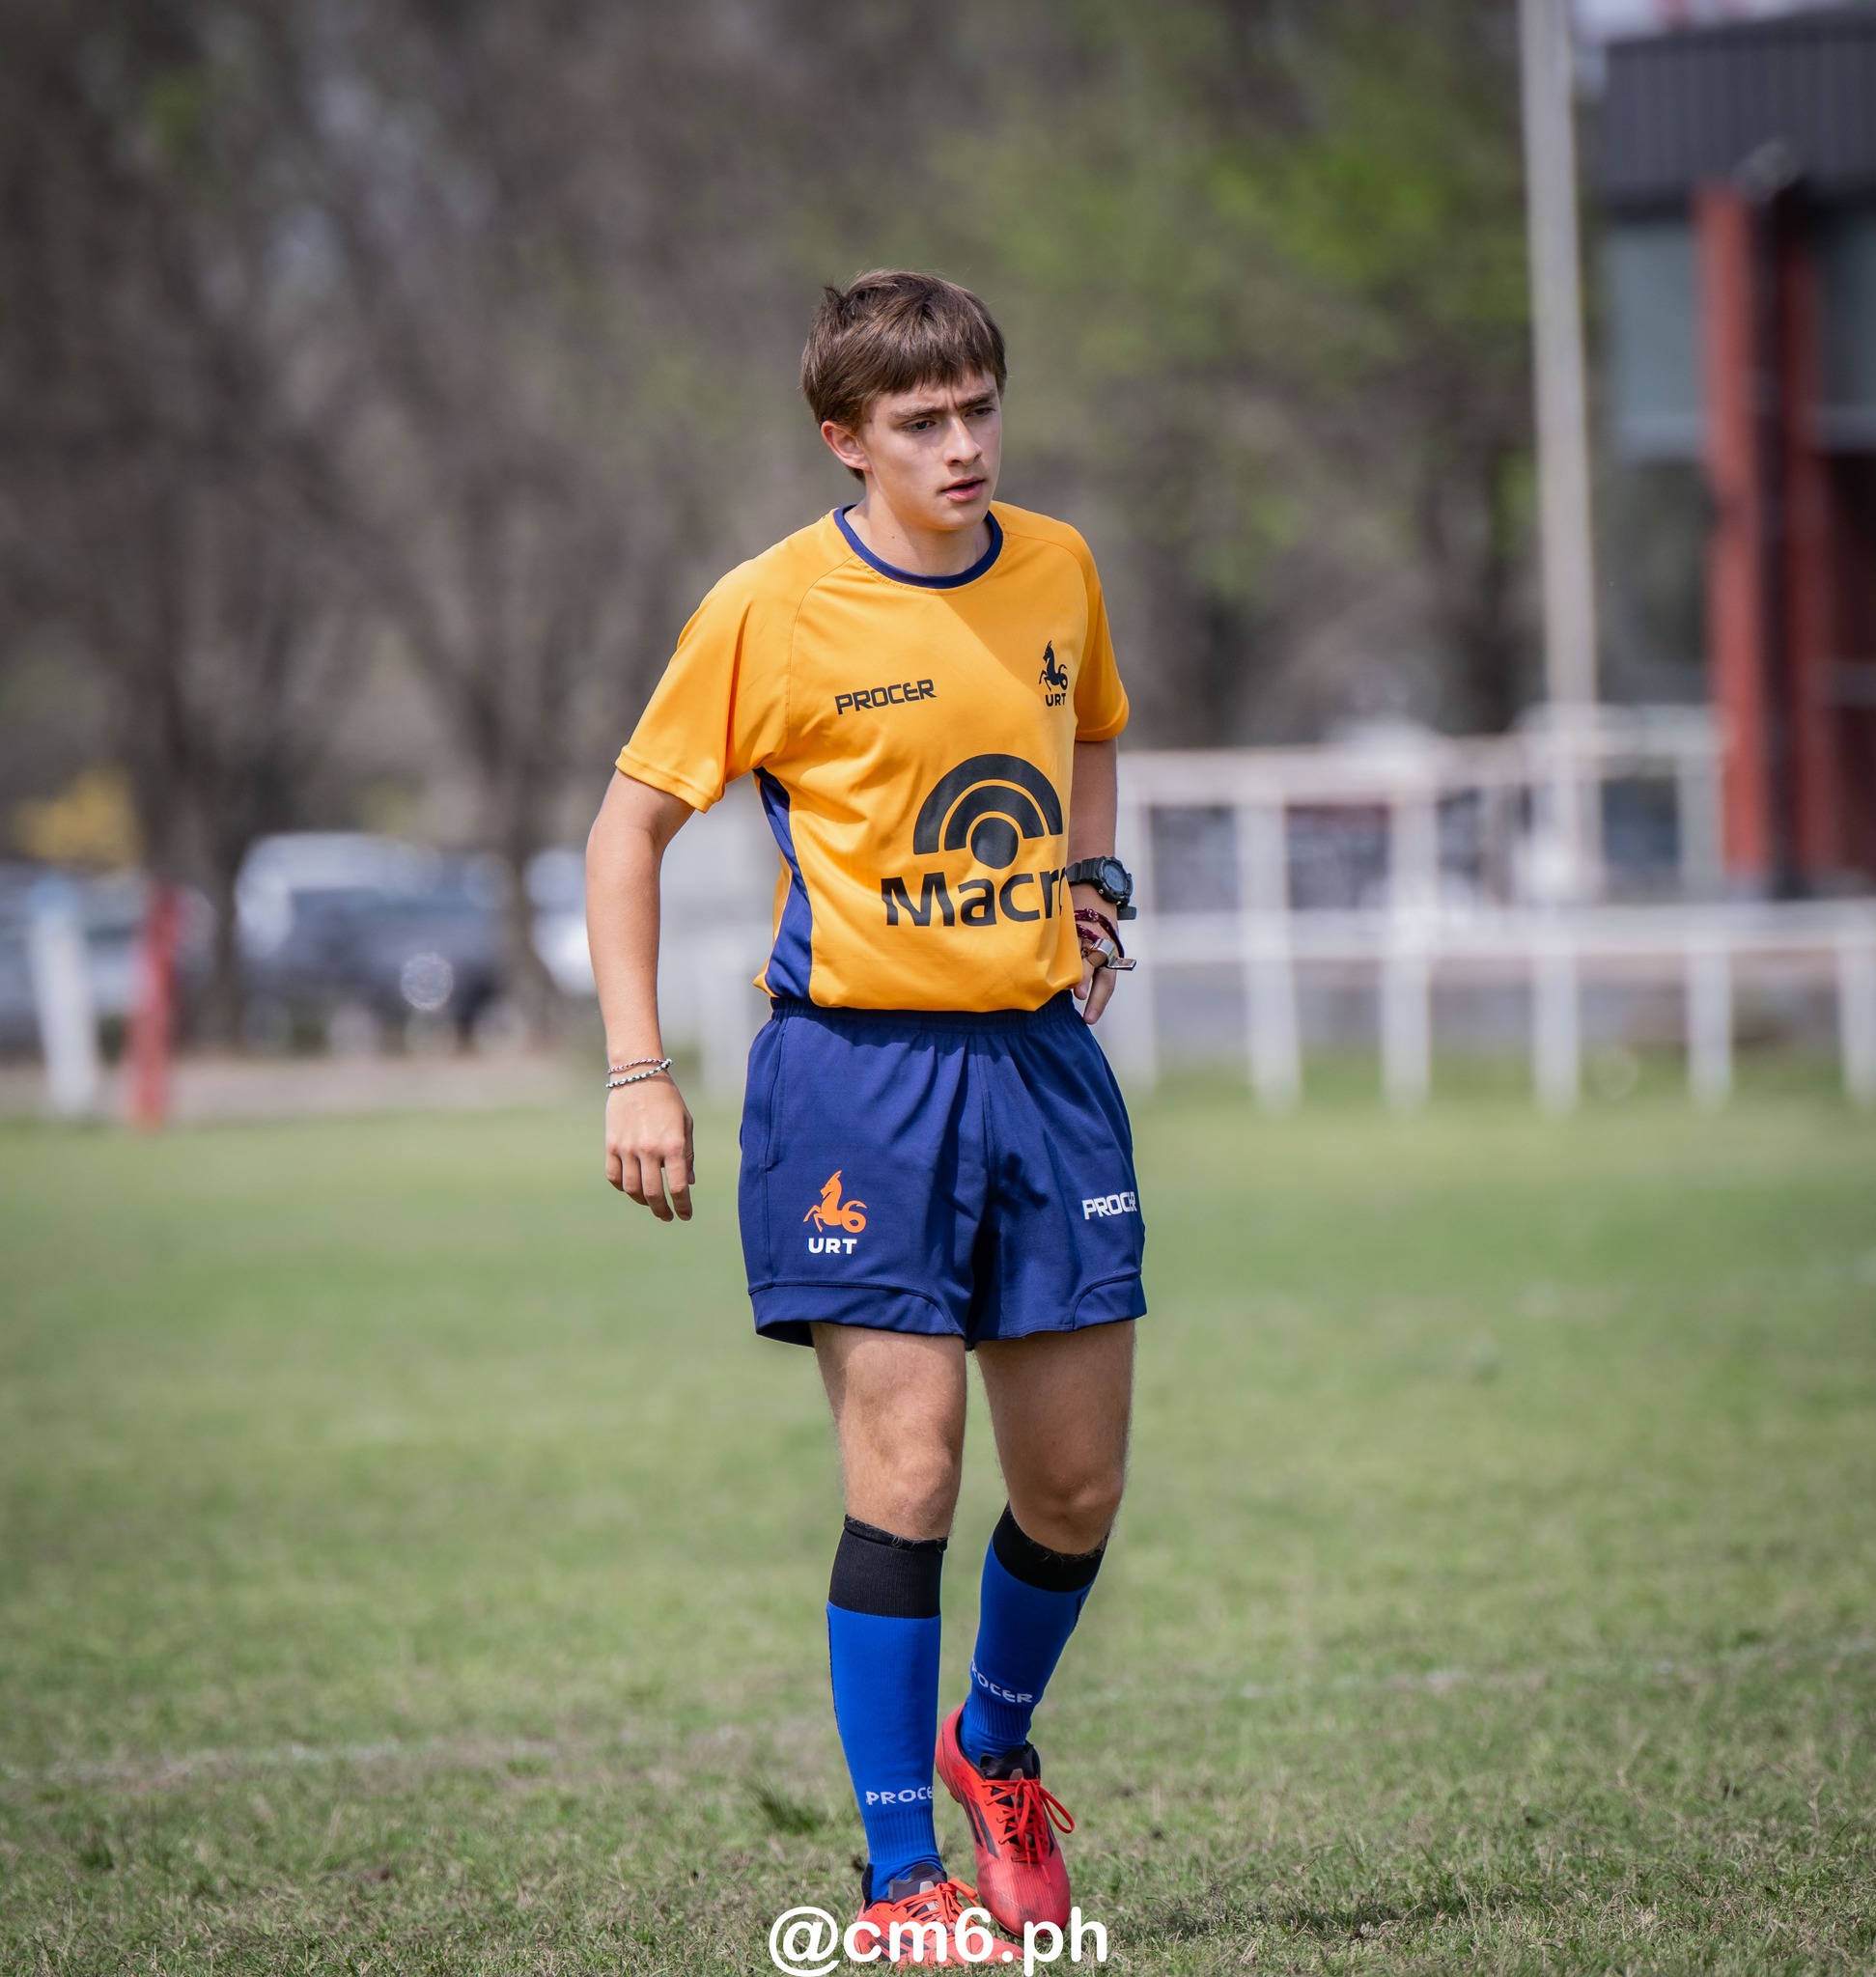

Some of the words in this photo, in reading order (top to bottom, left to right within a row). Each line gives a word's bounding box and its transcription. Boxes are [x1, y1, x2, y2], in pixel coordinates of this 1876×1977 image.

[834, 679, 937, 714] PROCER
[1045, 693, 1066, 707] URT
[881, 867, 1066, 927] Macr
[808, 1238, 857, 1254] URT
[865, 1786, 934, 1805] PROCE
